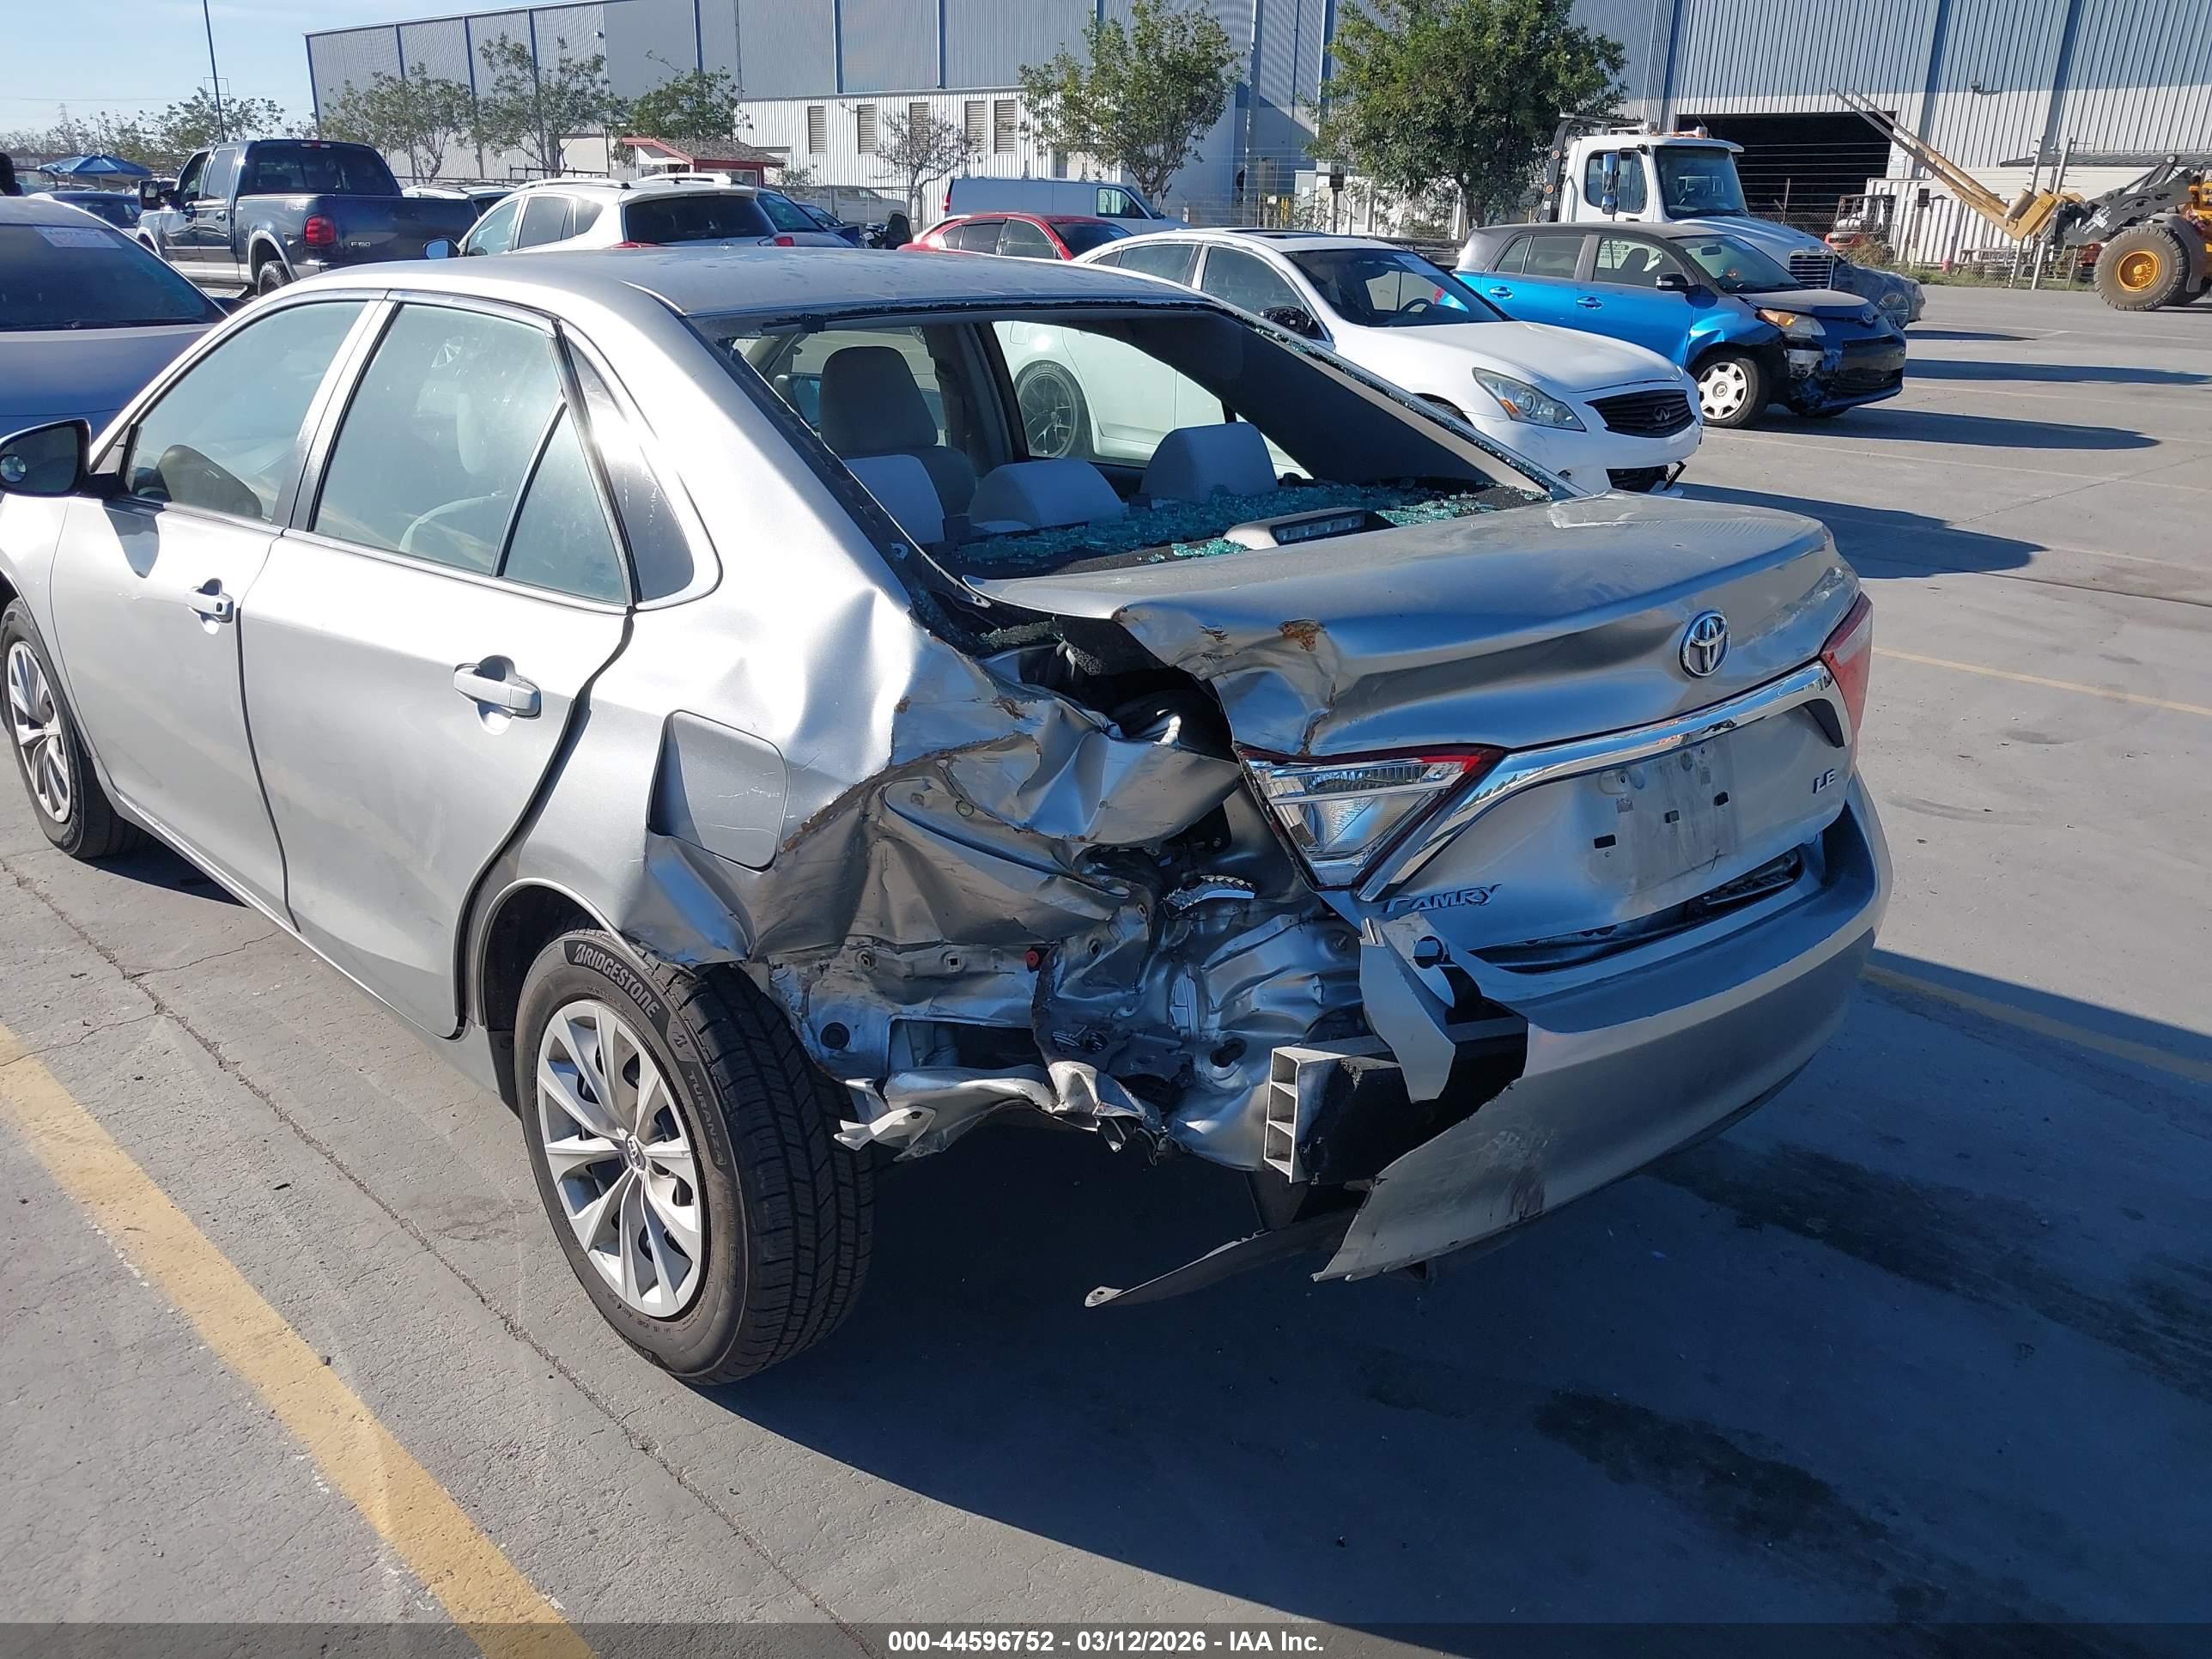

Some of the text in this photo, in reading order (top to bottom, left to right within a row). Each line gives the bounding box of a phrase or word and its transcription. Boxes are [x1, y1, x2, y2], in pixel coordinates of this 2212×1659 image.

[1813, 769, 1835, 794] LE
[1383, 884, 1503, 913] CAMRY
[574, 943, 660, 1018] BRIDGESTONE
[689, 1070, 726, 1165] TURANZA
